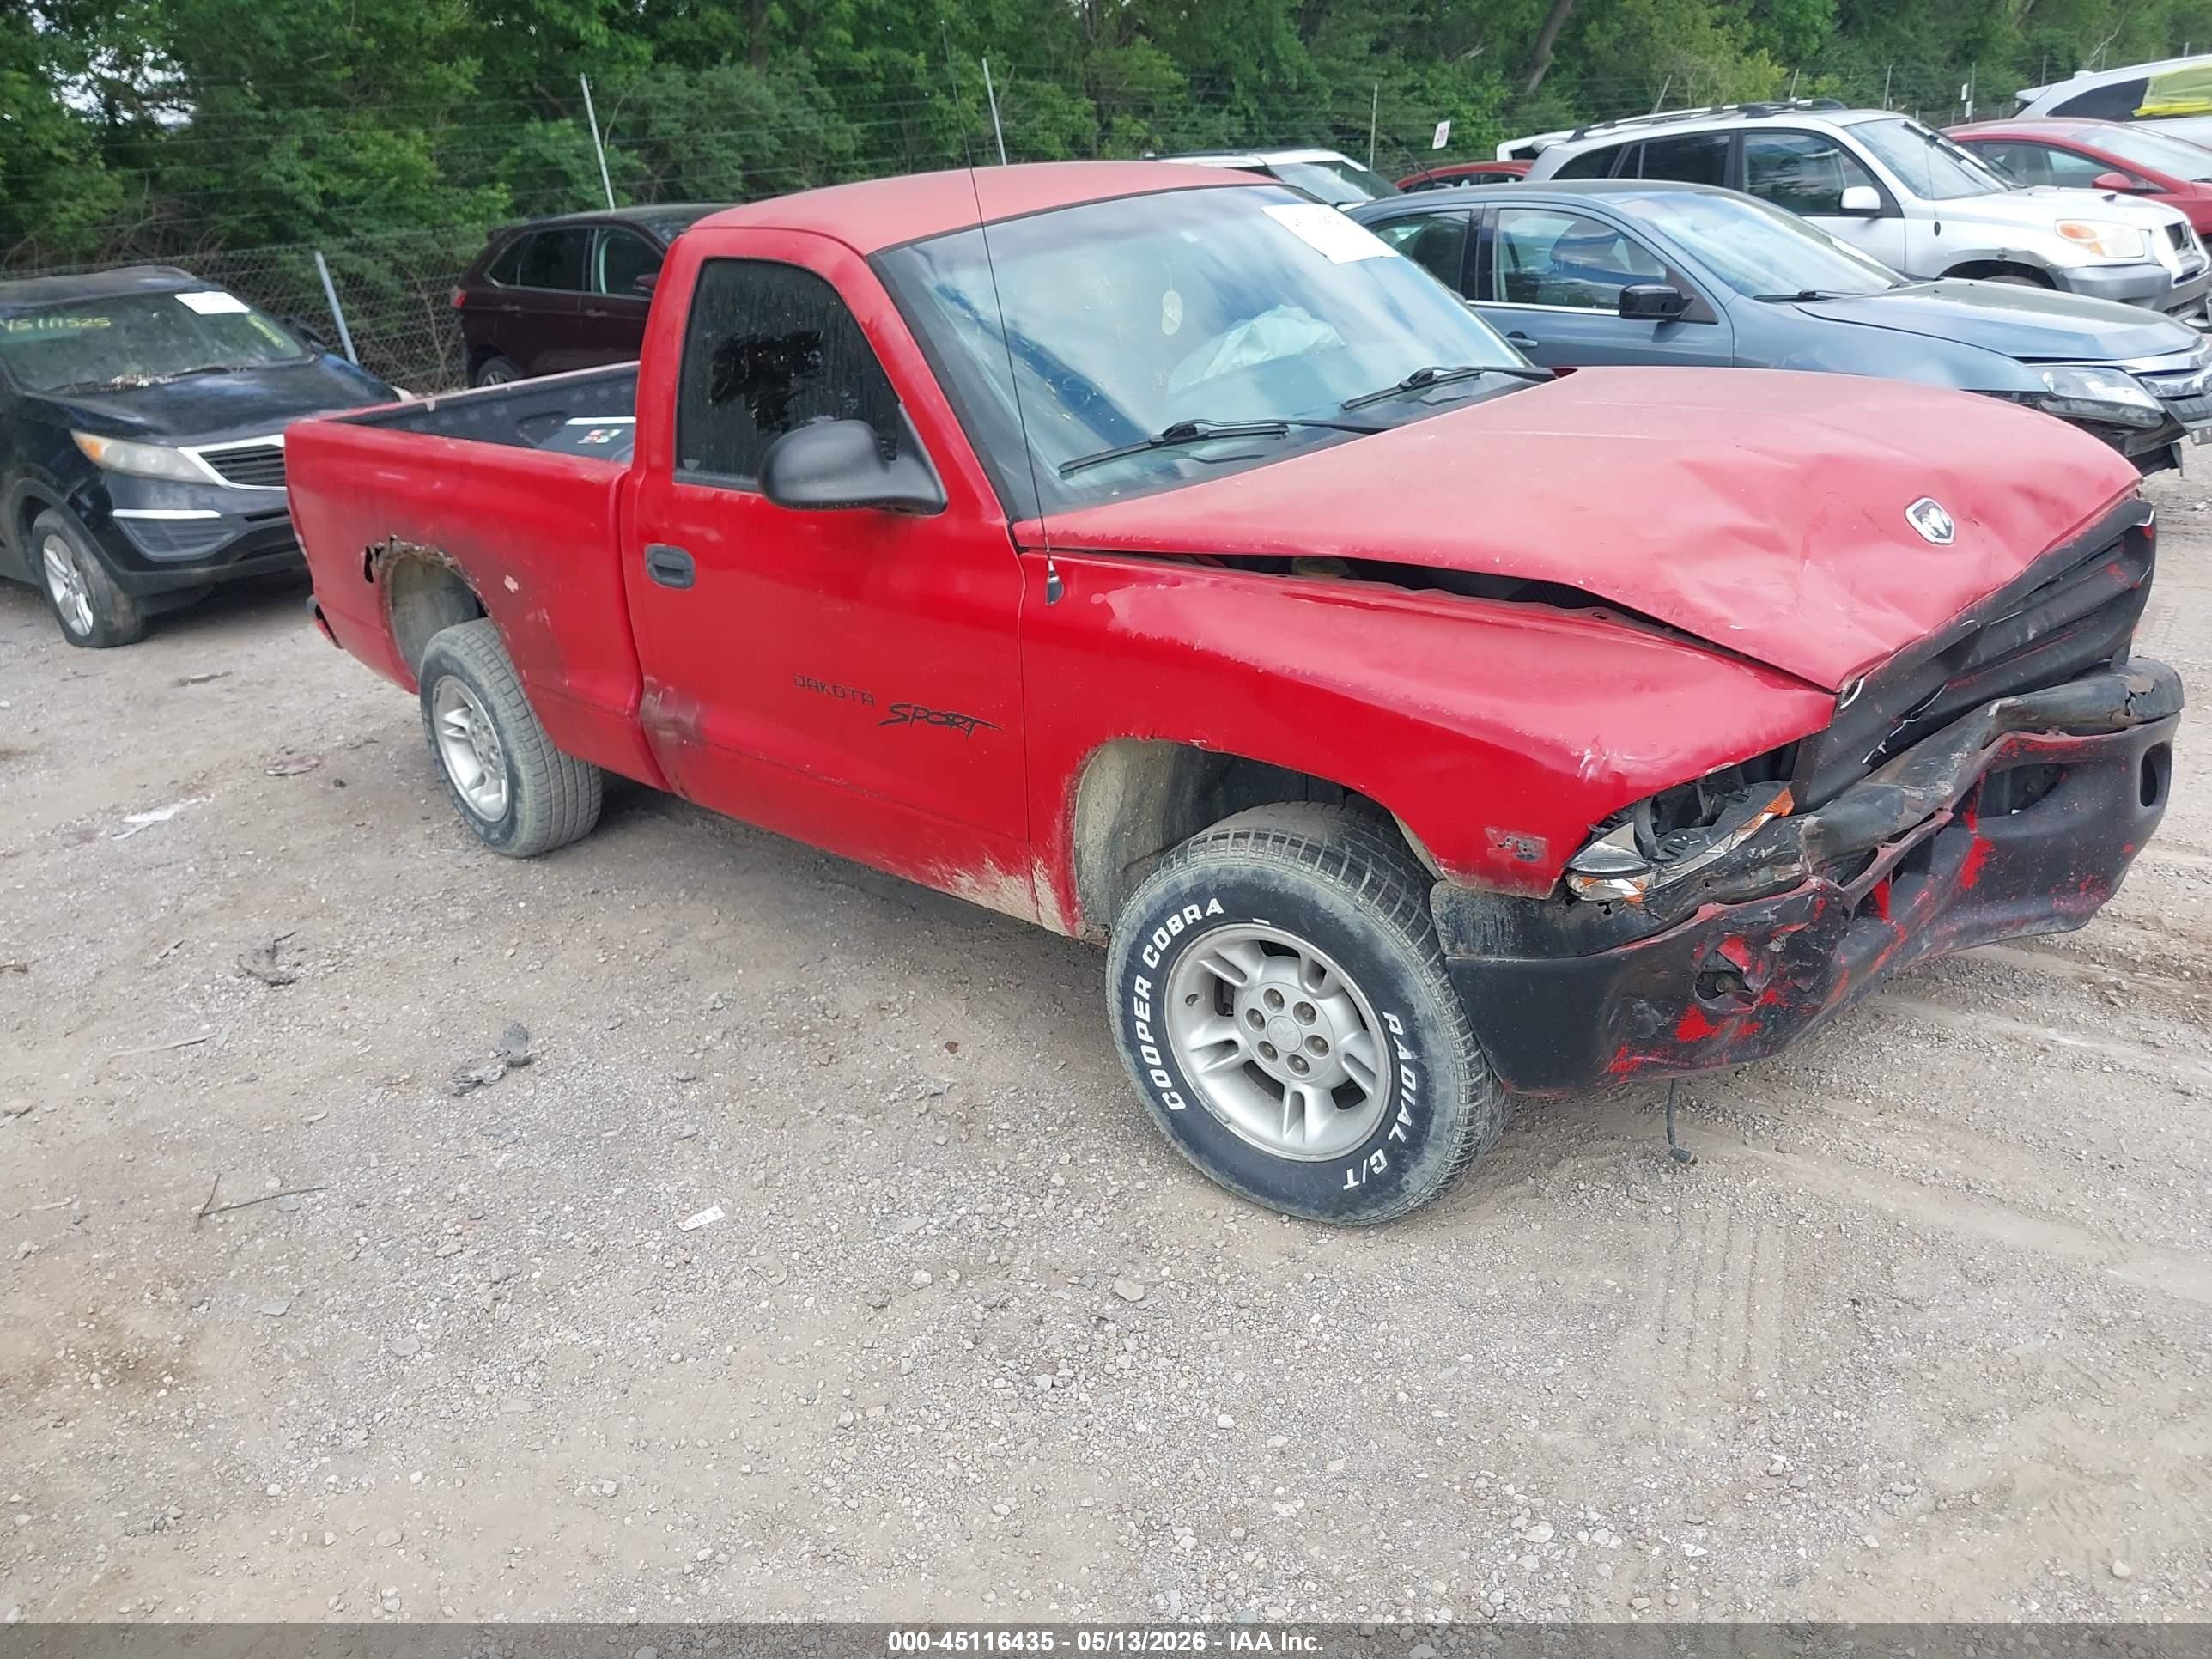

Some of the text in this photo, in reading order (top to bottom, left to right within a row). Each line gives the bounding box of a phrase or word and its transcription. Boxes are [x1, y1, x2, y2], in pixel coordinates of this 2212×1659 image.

[878, 702, 1005, 741] SPORT
[1133, 898, 1224, 1111] COOPER COBRA
[1343, 1011, 1417, 1190] RADIAL G/T
